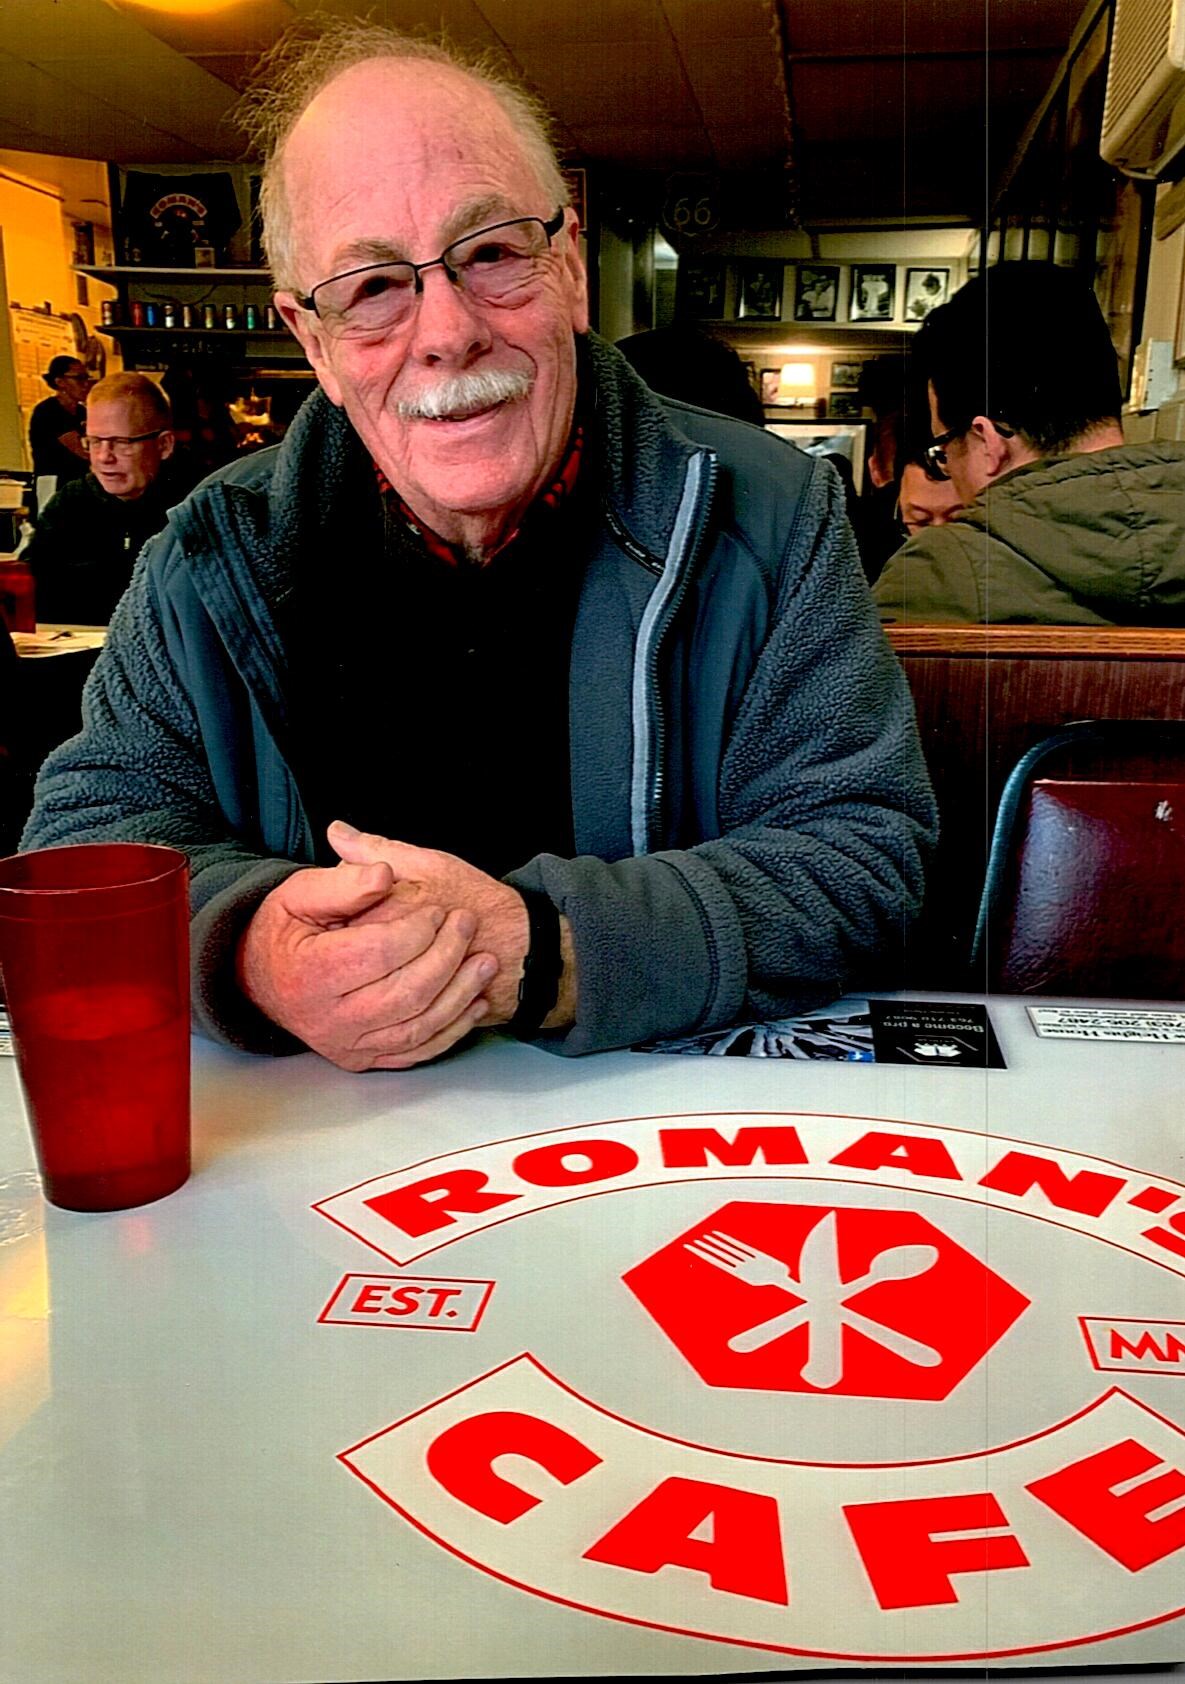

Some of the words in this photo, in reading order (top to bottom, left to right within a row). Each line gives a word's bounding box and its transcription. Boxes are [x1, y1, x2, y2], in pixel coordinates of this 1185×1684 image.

[674, 198, 710, 225] 66
[351, 1285, 462, 1318] EST.
[426, 1411, 1185, 1610] CAFE
